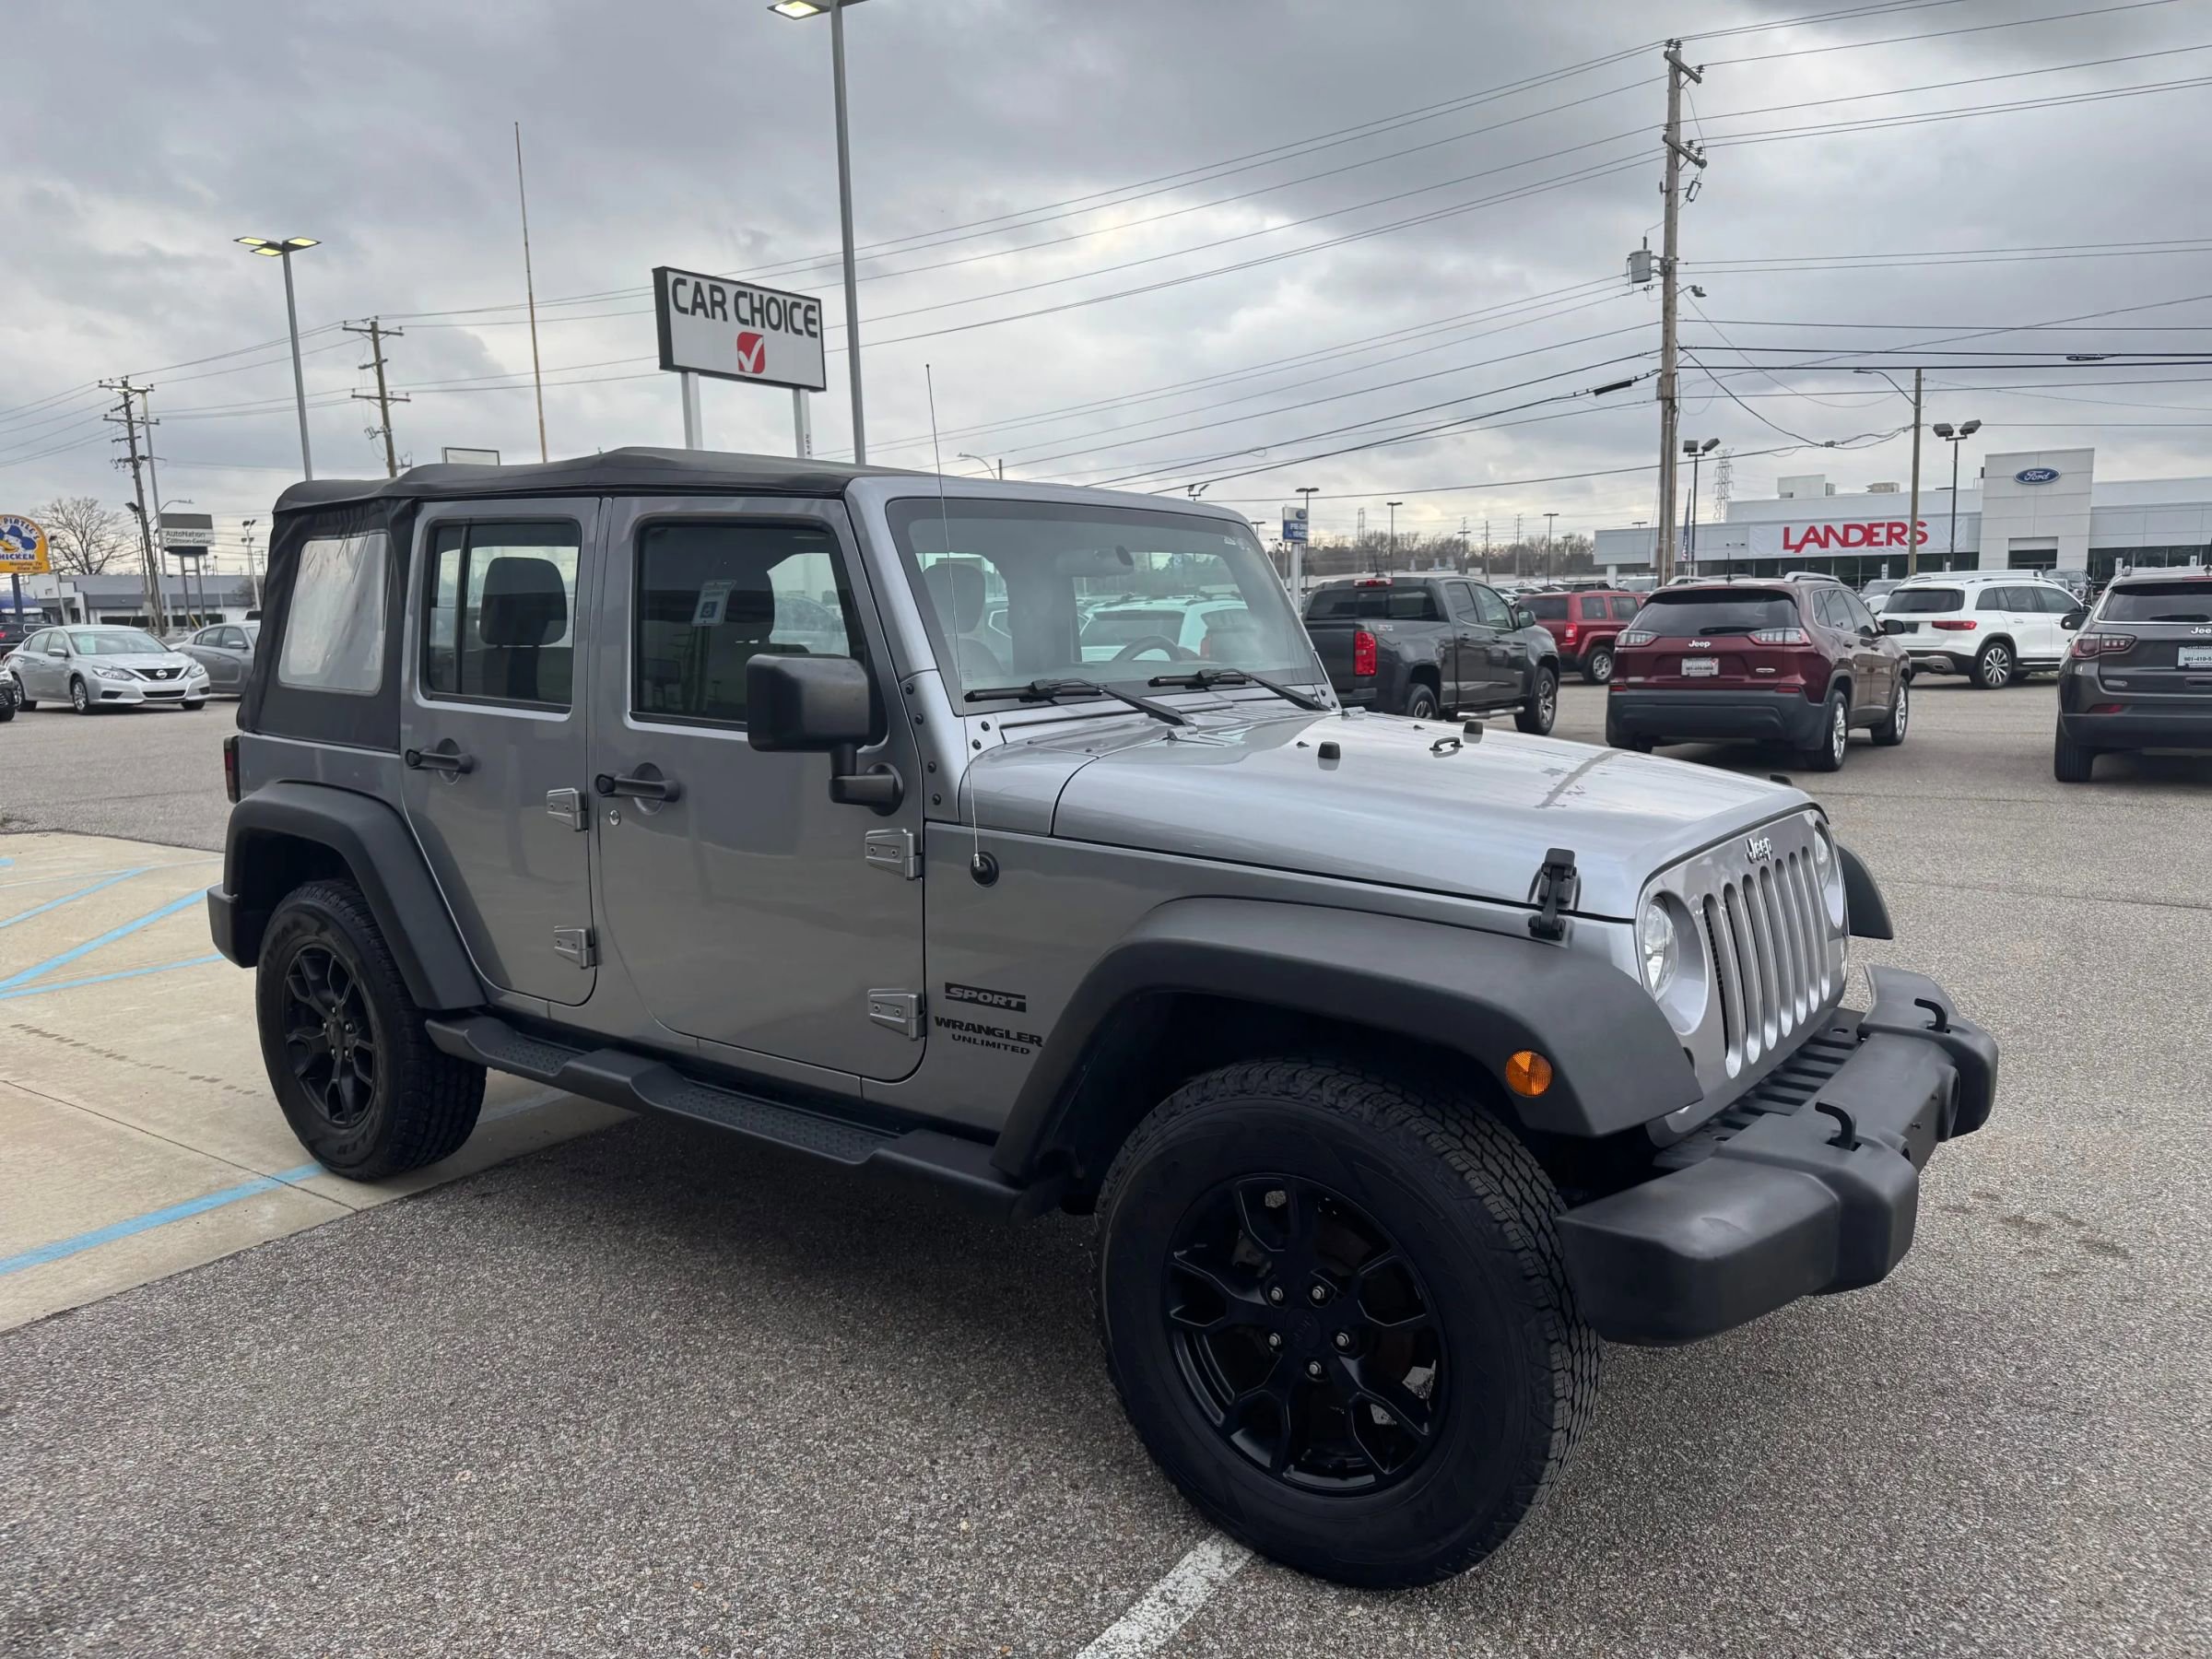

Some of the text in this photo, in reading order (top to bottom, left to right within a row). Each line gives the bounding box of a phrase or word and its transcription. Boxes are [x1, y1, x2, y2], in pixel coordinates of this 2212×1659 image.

[672, 277, 818, 338] CAR CHOICE
[1783, 521, 1928, 553] LANDERS
[1688, 640, 1711, 648] Jeep
[1735, 837, 1772, 864] Jeep
[949, 987, 1025, 1007] SPORT
[935, 1016, 1042, 1047] WRANGLER
[952, 1034, 1030, 1054] UNLIMITED
